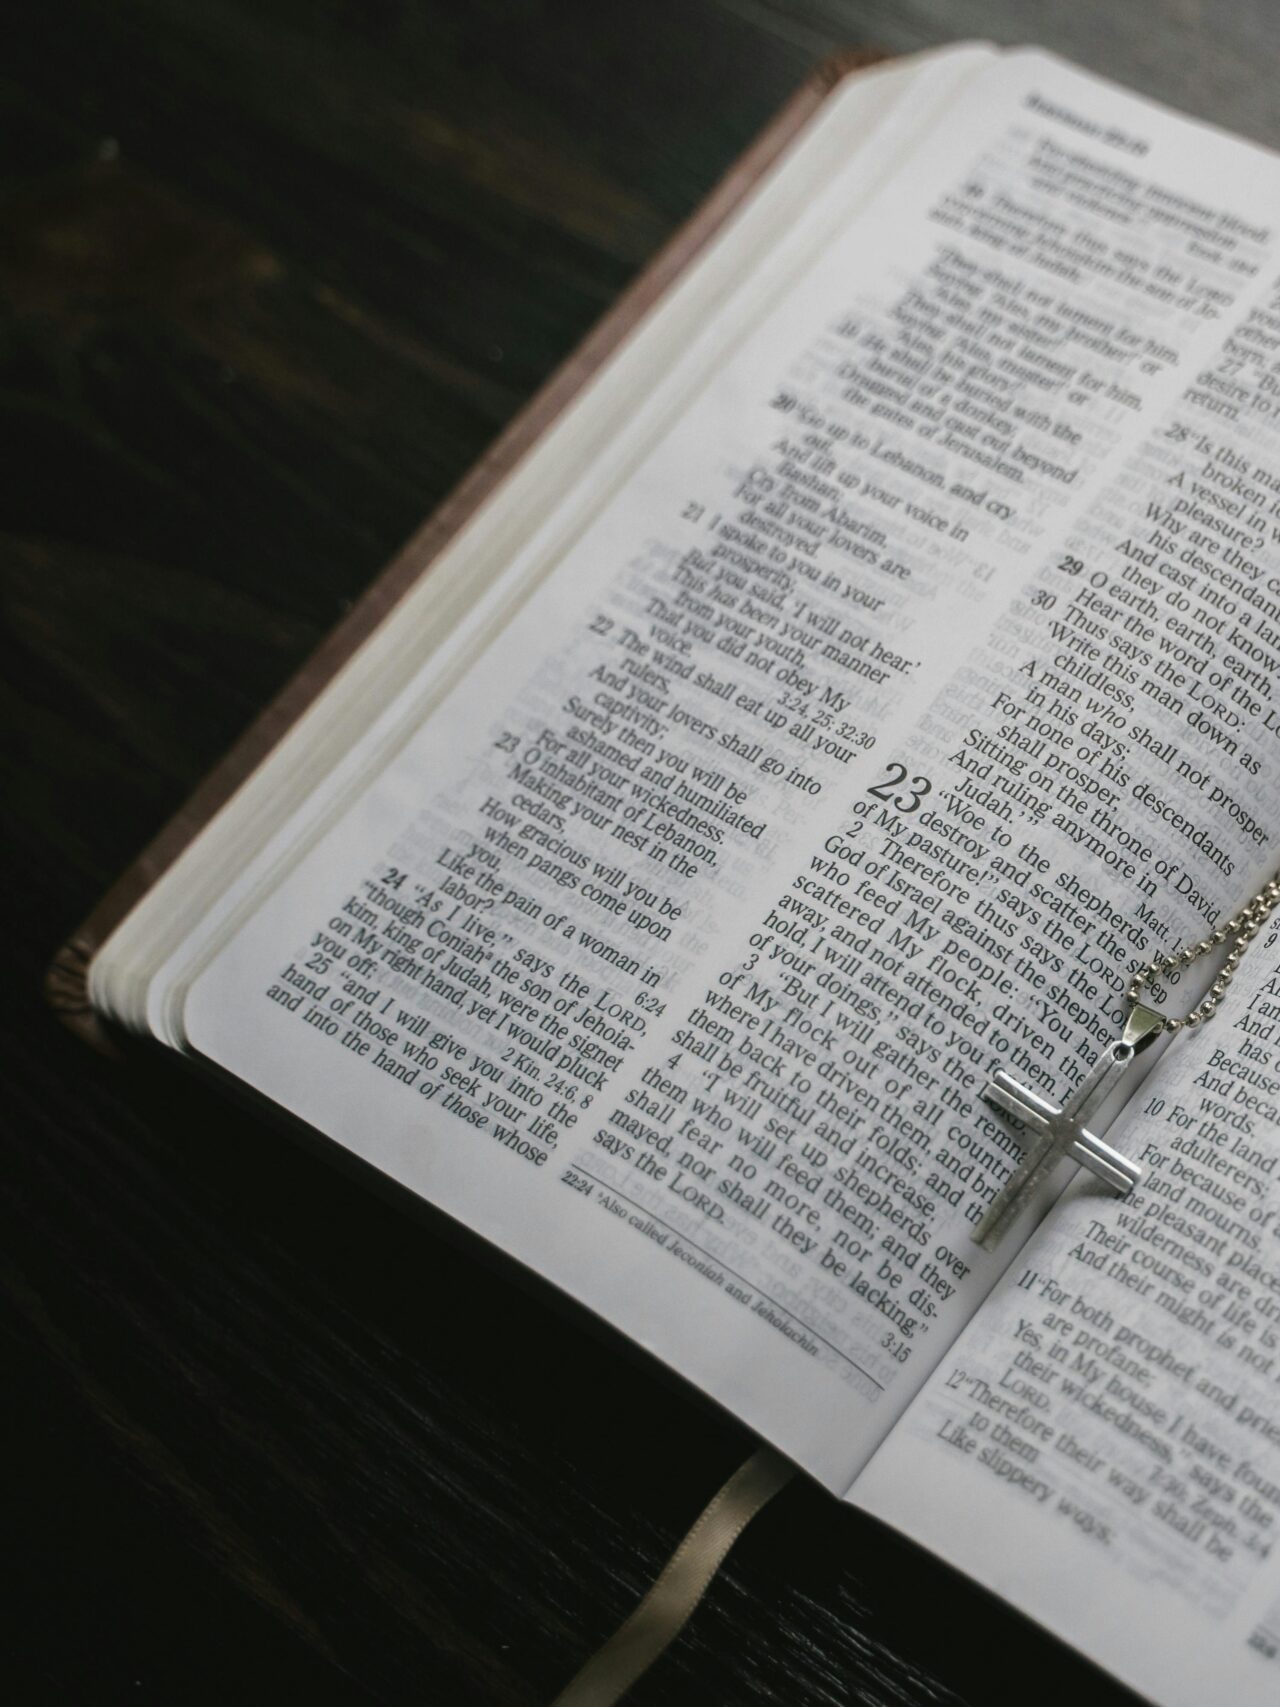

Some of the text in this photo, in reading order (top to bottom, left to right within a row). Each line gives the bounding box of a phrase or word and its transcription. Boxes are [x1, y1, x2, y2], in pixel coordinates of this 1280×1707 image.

[1250, 392, 1272, 412] to
[1145, 501, 1187, 535] Why
[1187, 530, 1220, 554] are
[1221, 546, 1266, 581] they
[1030, 589, 1245, 733] 30 Thus says the LORD:
[1056, 554, 1272, 701] 29 O earth, earth, earth,
[1074, 586, 1124, 621] Hear
[1122, 615, 1155, 642] the
[1158, 636, 1209, 675] word
[1207, 671, 1234, 692] of
[1230, 685, 1262, 716] the
[776, 690, 876, 750] 3:24, 25; 32:30
[565, 726, 767, 840] ashamed and humiliated
[866, 762, 933, 814] 23
[962, 728, 1221, 931] Sitting on the throne of David,
[435, 847, 661, 988] Like the pain of a woman in
[938, 789, 1149, 951] “Woe to the shepherds
[380, 867, 646, 1037] 24 “As I live,” says the LORD,
[1262, 932, 1278, 949] 9
[279, 962, 558, 1149] hand of those who seek your life,
[633, 990, 667, 1017] 6:24
[1232, 1013, 1276, 1041] And
[499, 1046, 594, 1109] 2 Kin. 24:6, 8
[591, 1128, 724, 1225] says the LORD.
[666, 1052, 971, 1280] 4 “I will set up shepherds over
[1142, 1096, 1166, 1116] 10
[1164, 1104, 1198, 1130] For
[1196, 1120, 1229, 1146] the
[1228, 1136, 1279, 1174] land
[559, 1169, 594, 1197] 22:24
[627, 1215, 669, 1246] called
[664, 1239, 725, 1286] Jeconiah
[723, 1282, 752, 1305] and
[749, 1300, 819, 1357] Jehoiachin
[880, 1331, 912, 1364] 3:15
